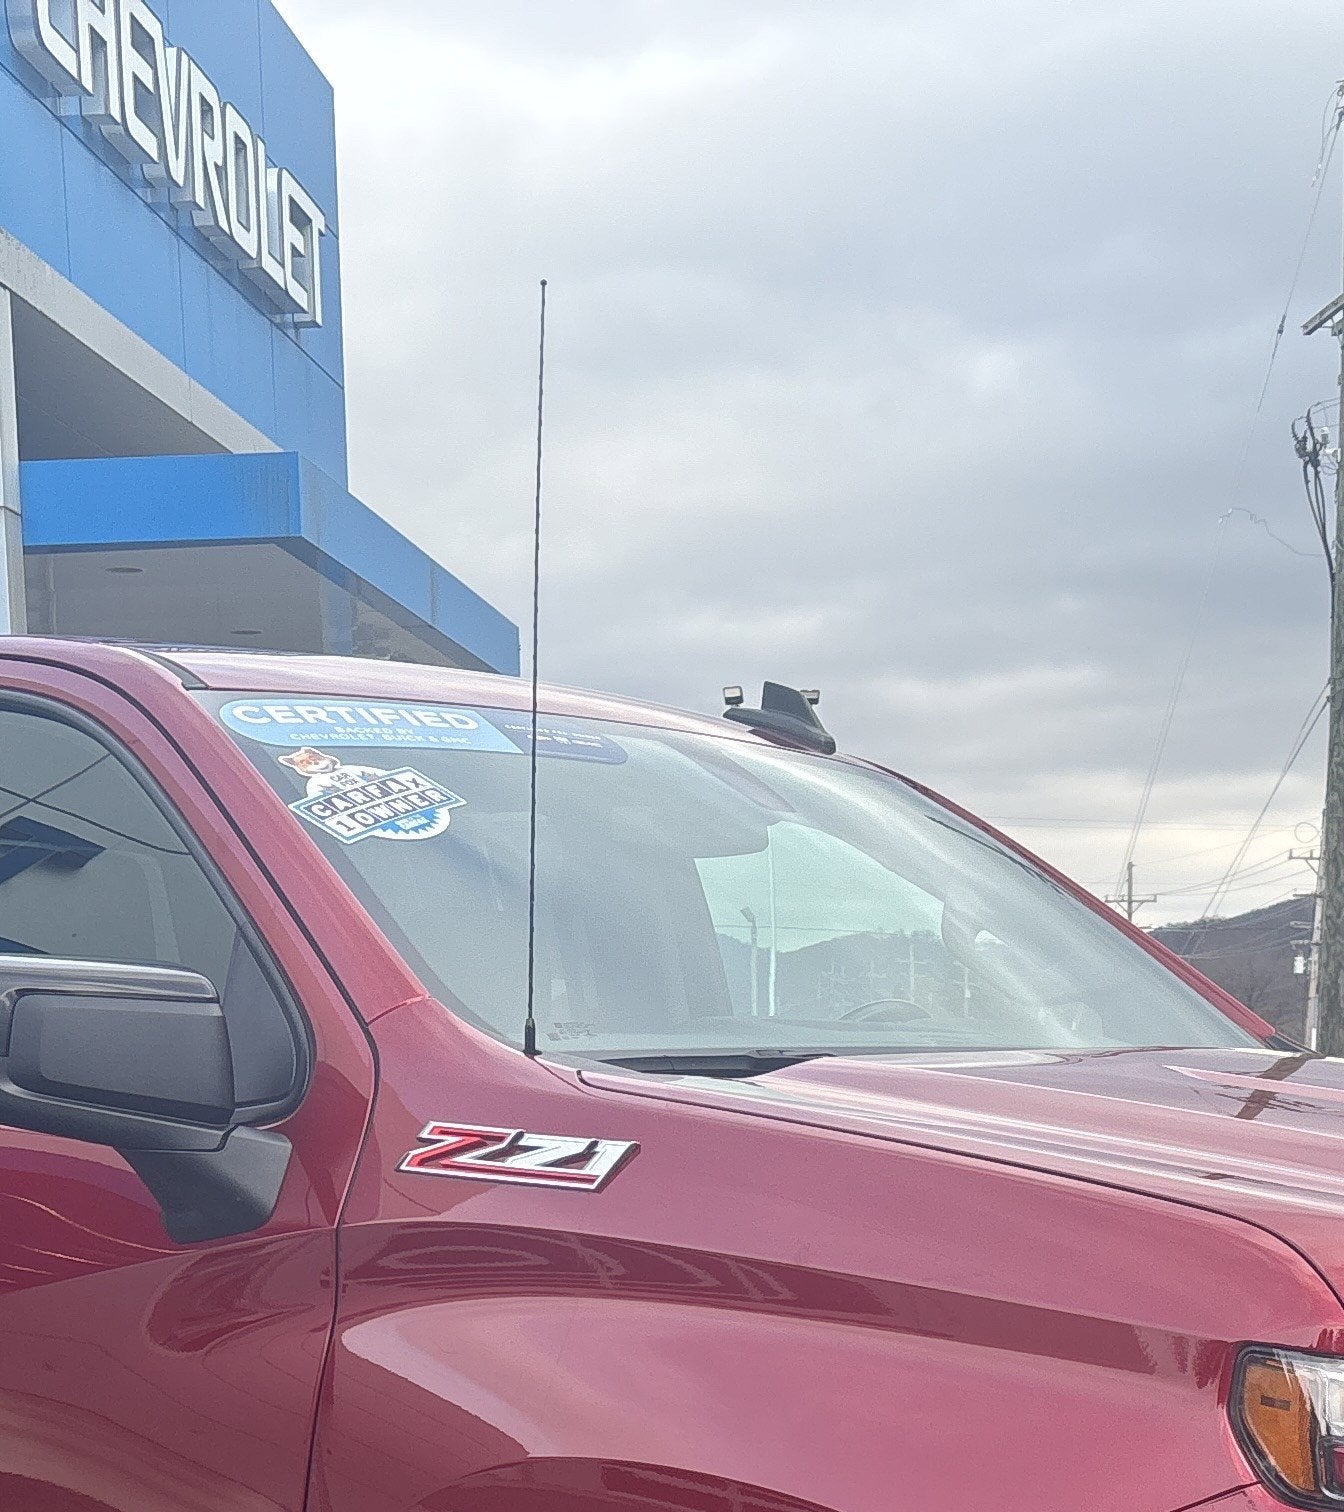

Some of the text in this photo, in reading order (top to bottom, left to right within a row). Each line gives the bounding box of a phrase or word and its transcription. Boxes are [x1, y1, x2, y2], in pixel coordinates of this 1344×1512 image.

[231, 704, 480, 731] CERTIFIED
[310, 778, 427, 817] CARFAX
[395, 1120, 641, 1193] Z71
